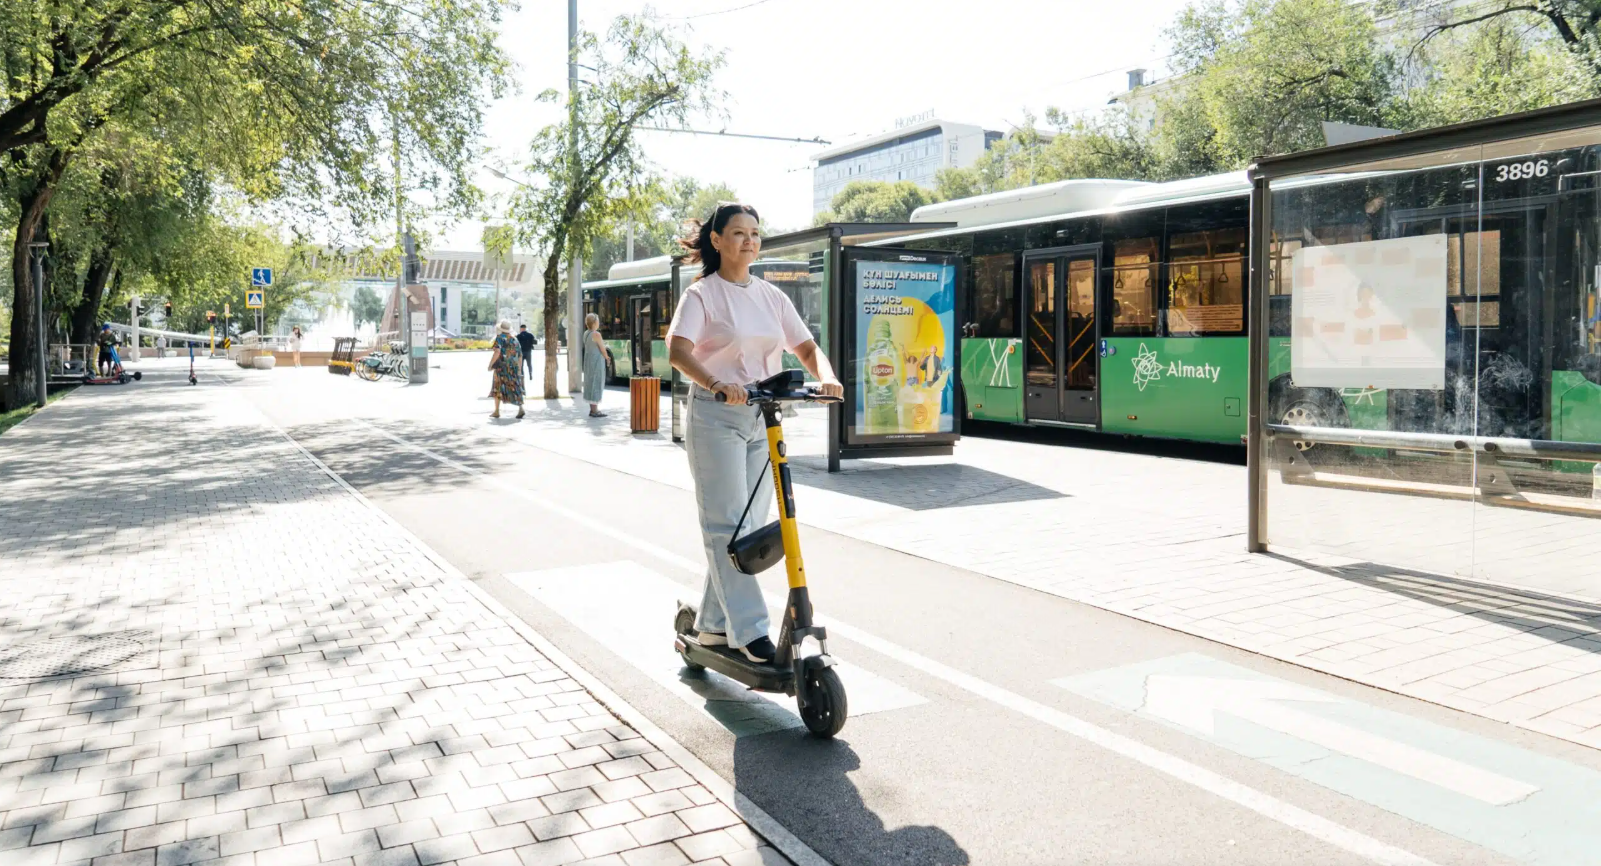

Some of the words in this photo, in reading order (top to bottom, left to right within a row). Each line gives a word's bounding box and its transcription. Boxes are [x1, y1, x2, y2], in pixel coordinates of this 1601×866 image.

[1496, 160, 1549, 182] 3896
[863, 269, 882, 279] КҮН
[884, 271, 938, 281] ШУАҒЫМЕН
[863, 294, 902, 305] ДЕЛИСЬ
[863, 305, 914, 315] СОЛНЦЕМ!
[872, 366, 893, 375] Lipton
[1166, 360, 1220, 383] Almaty
